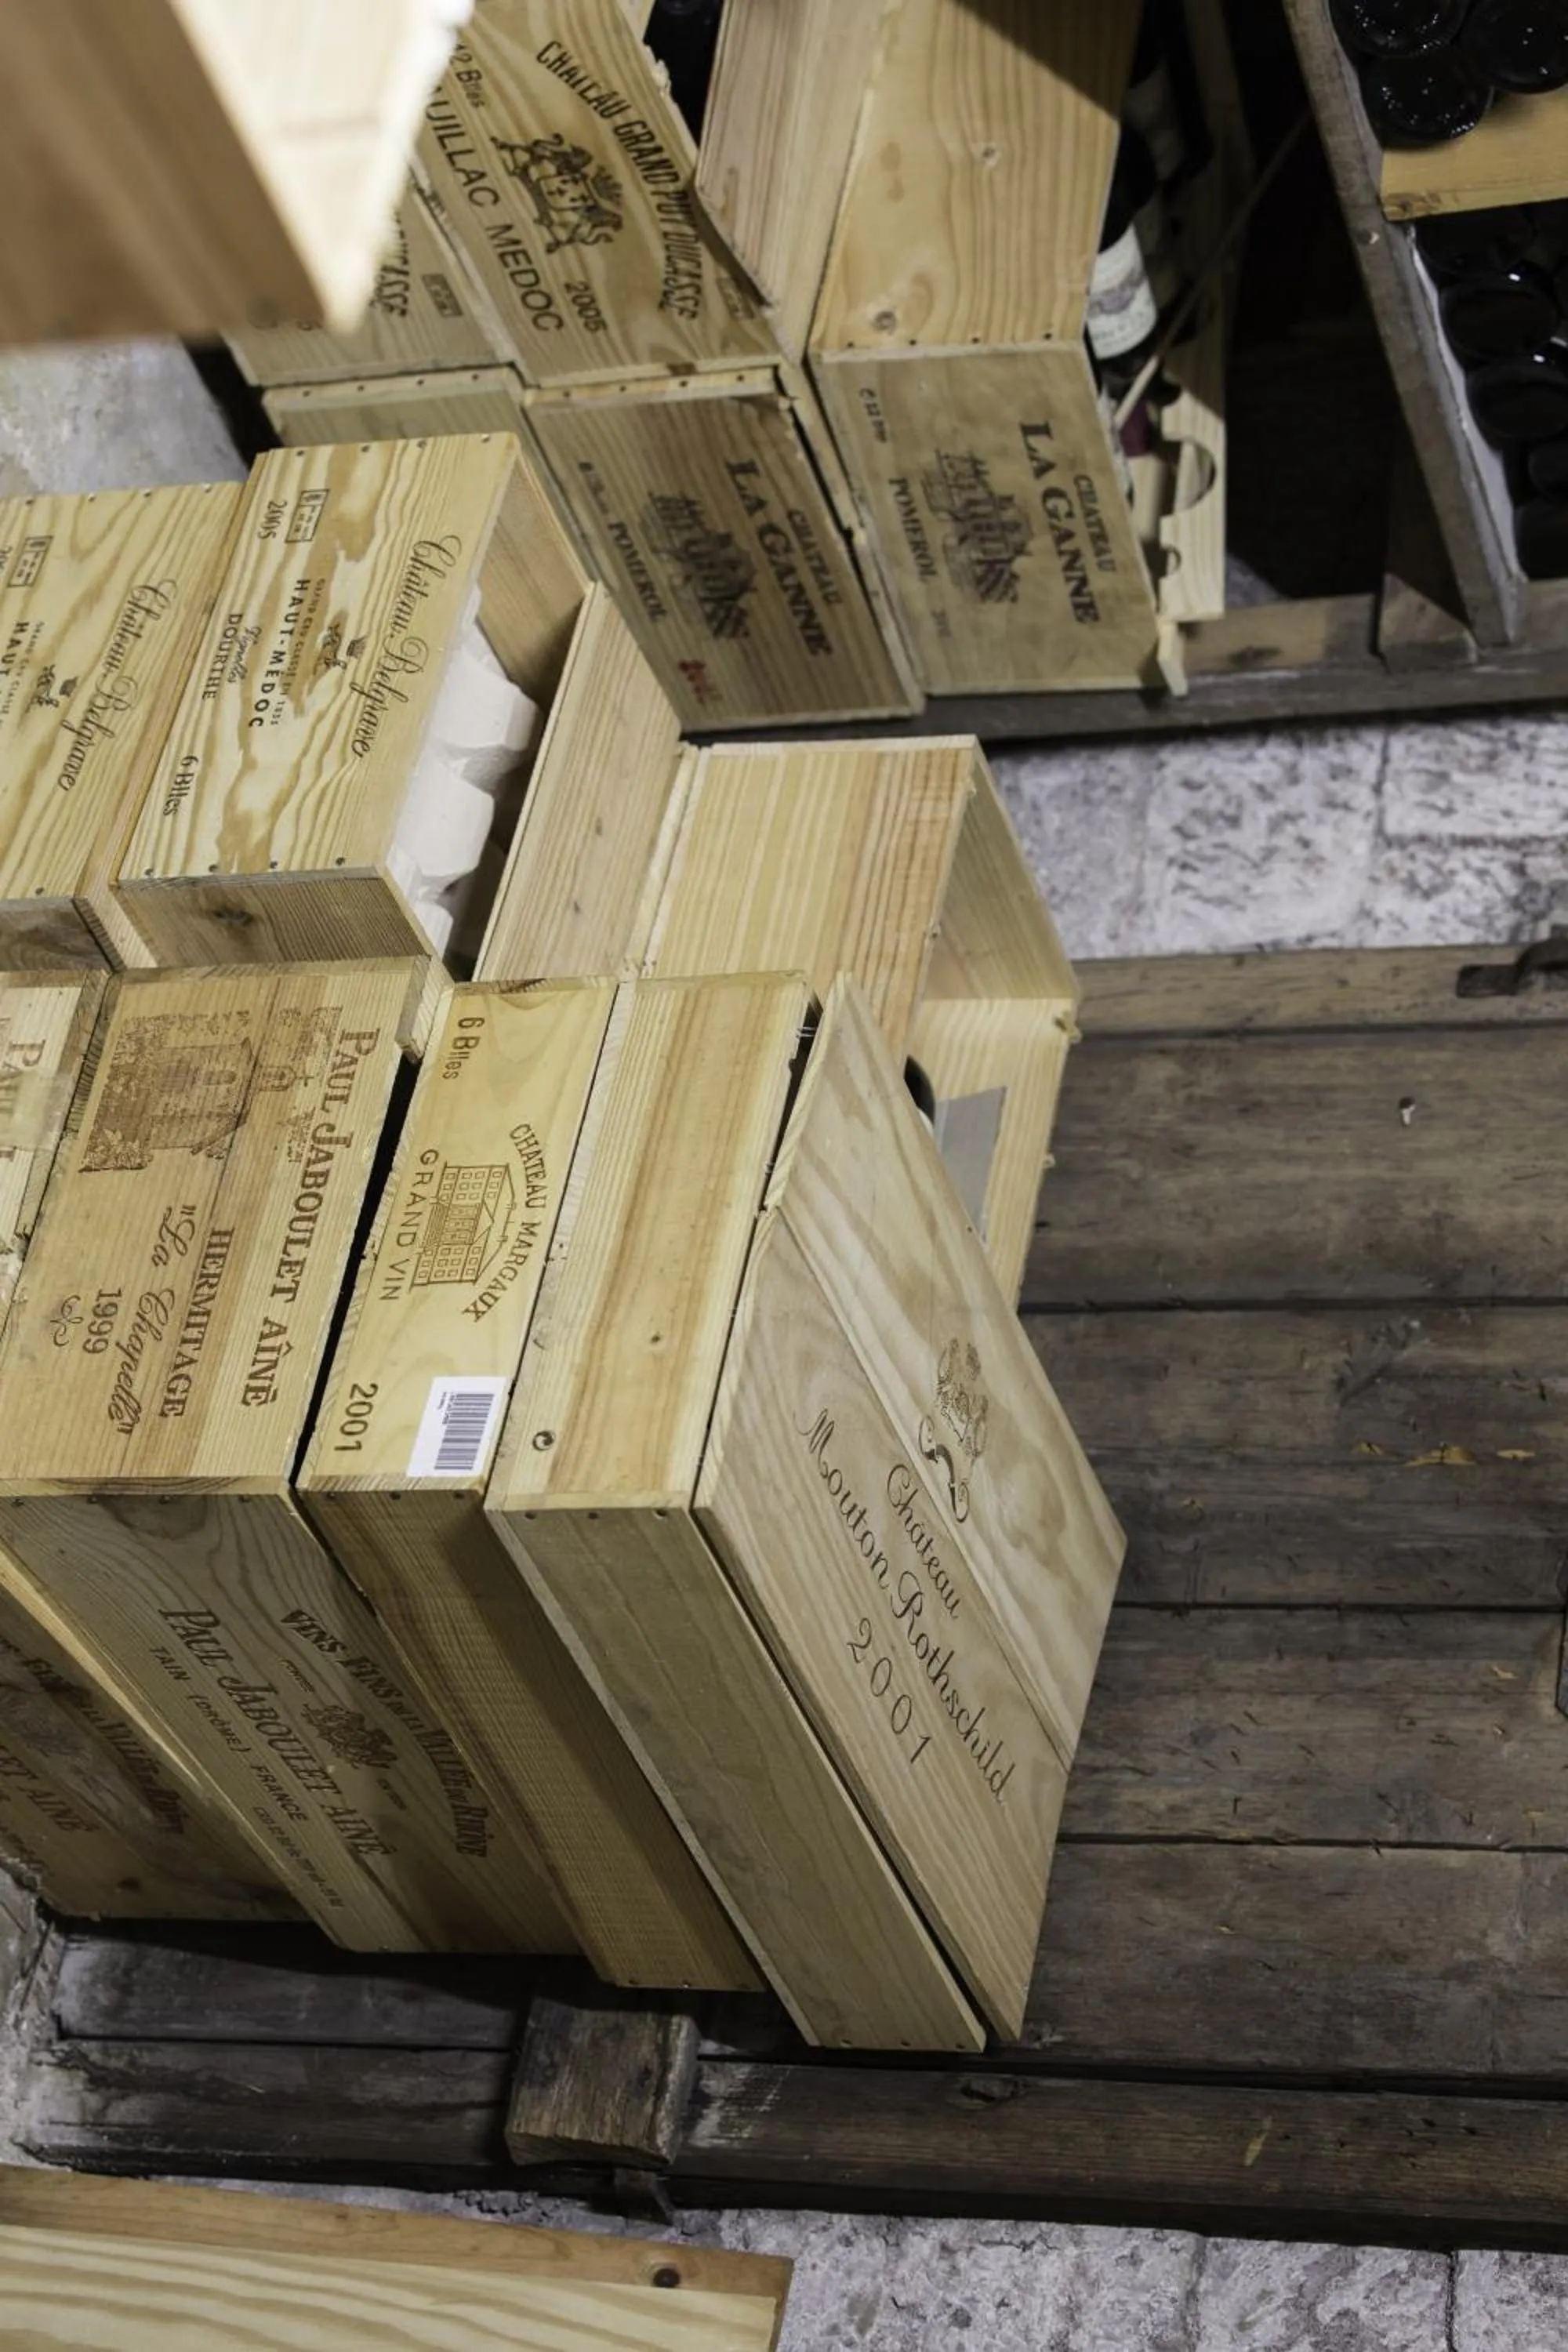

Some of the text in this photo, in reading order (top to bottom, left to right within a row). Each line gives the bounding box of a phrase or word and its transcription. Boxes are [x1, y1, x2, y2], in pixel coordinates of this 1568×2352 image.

[425, 85, 501, 209] UILLAC
[485, 223, 565, 332] MEDOC
[612, 119, 681, 186] GRAND
[658, 230, 702, 321] DUCASSE
[608, 521, 668, 623] POMEROL
[724, 459, 834, 657] LA GANNE
[786, 509, 843, 605] CHATEAU
[887, 475, 938, 584] POMEROL
[1018, 419, 1101, 624] LA GANNE
[1073, 474, 1117, 573] CHATEAU
[201, 613, 244, 701] DOURTHE
[350, 534, 463, 760] Château Belgrave
[57, 672, 138, 792] Belgrave
[180, 753, 199, 770] 6
[457, 1015, 485, 1031] 6
[240, 1026, 382, 1409] PAUL JABOULET AÎNÉ
[379, 1148, 441, 1301] GRAND VIN
[461, 1123, 548, 1323] CHATEAU MARGAUX
[82, 1286, 122, 1356] 1999
[158, 1225, 236, 1421] HERMITAGE
[334, 1381, 379, 1454] 2001
[280, 1608, 347, 1653] VINS
[334, 1654, 405, 1700] FINS
[793, 1407, 1016, 1805] Mouton Rothschild
[149, 1645, 193, 1682] TAIN
[249, 1763, 309, 1826] FRANCE
[158, 1606, 234, 1670] PAUL
[216, 1673, 343, 1797] JABOULET
[846, 1617, 933, 1767] 2001
